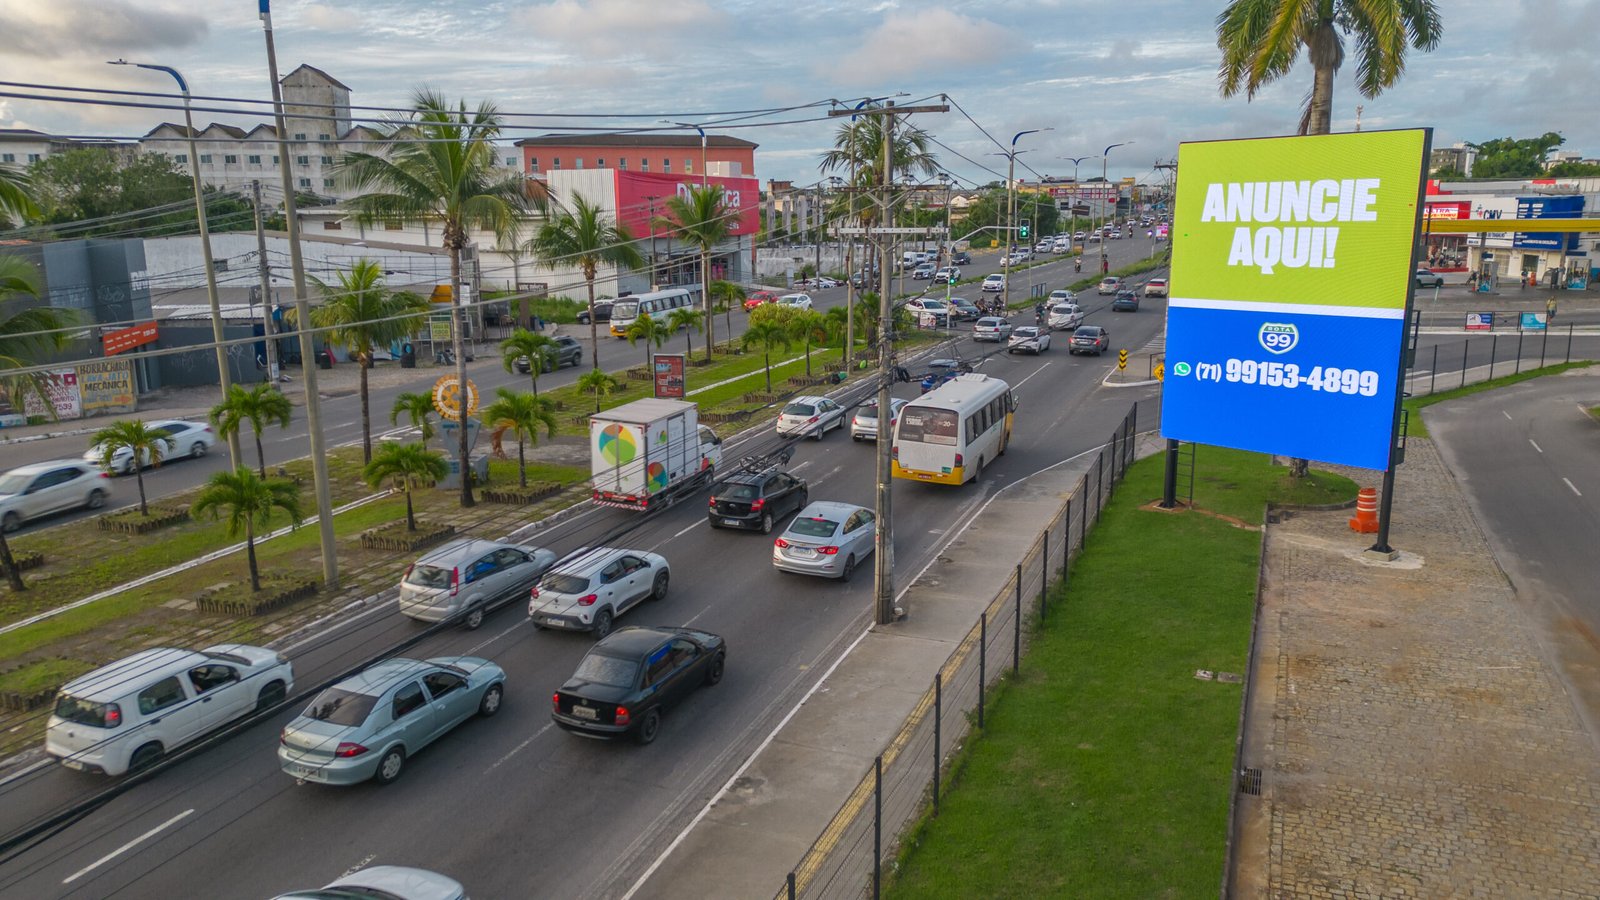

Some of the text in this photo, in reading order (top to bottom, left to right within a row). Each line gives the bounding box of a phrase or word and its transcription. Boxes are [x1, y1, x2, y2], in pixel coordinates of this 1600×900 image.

[1201, 178, 1380, 222] ANUNCIE
[1483, 209, 1502, 219] CMV
[1227, 226, 1340, 274] AQUI!
[1266, 333, 1291, 347] 99
[1196, 358, 1379, 397] (71) 99153-4899
